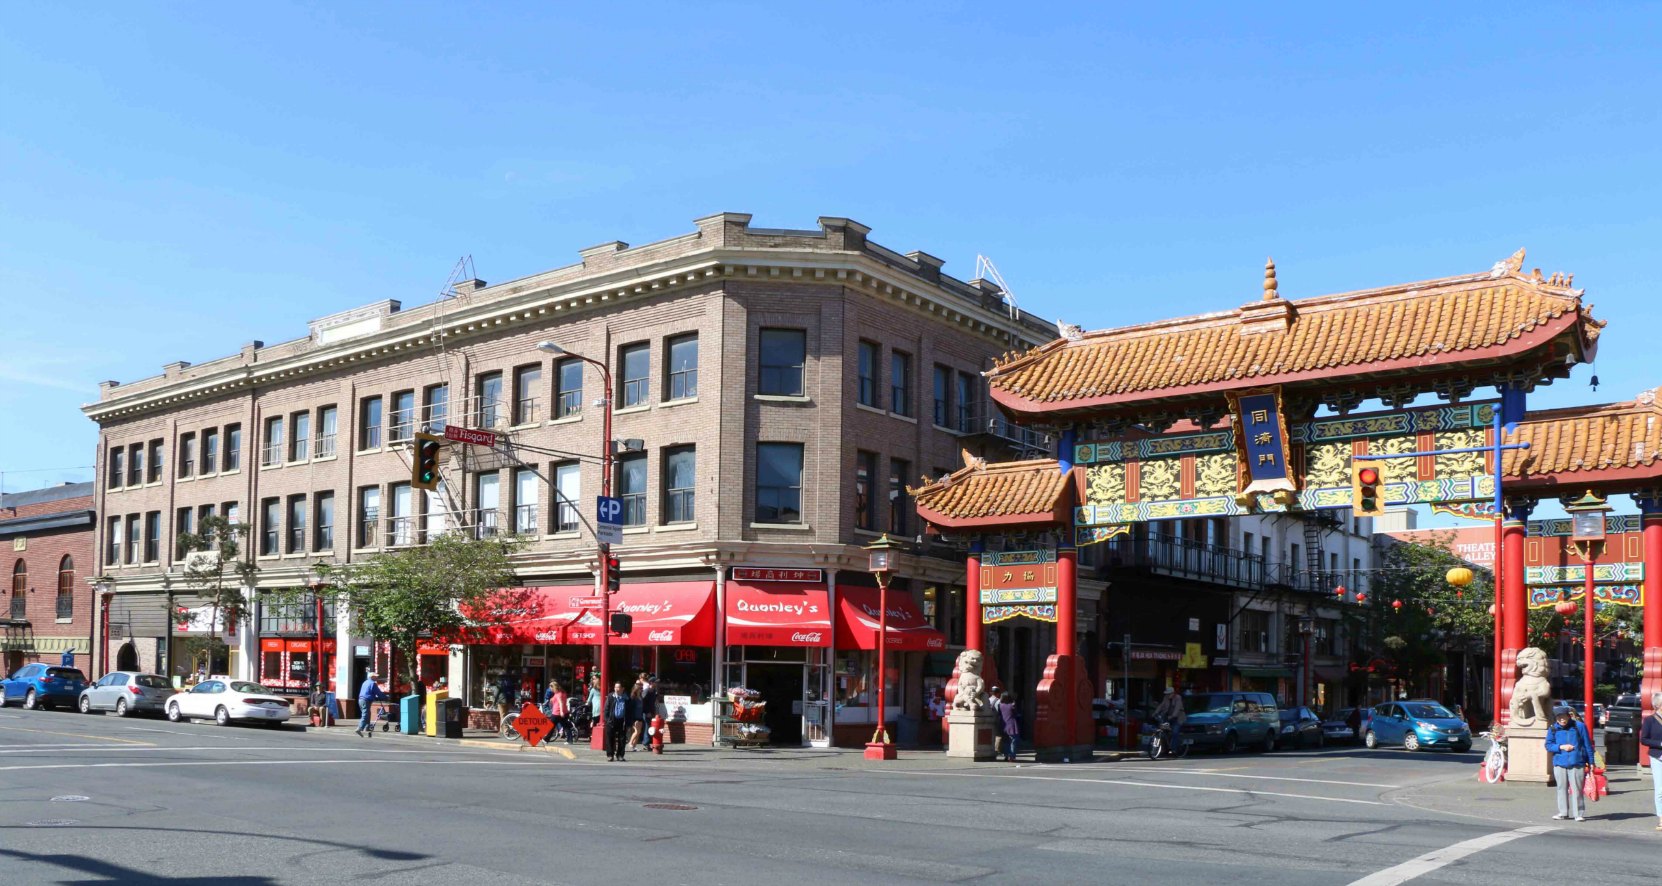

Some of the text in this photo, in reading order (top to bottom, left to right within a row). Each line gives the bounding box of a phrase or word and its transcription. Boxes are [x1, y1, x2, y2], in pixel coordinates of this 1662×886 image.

[459, 429, 493, 444] Fisgard
[1251, 409, 1275, 466] 同濟門
[608, 499, 621, 521] P
[1456, 542, 1504, 553] THEATR
[737, 599, 819, 616] Quonley's
[791, 631, 823, 642] Coca-Cola
[674, 649, 697, 663] OPEN
[518, 717, 548, 726] DETOUR
